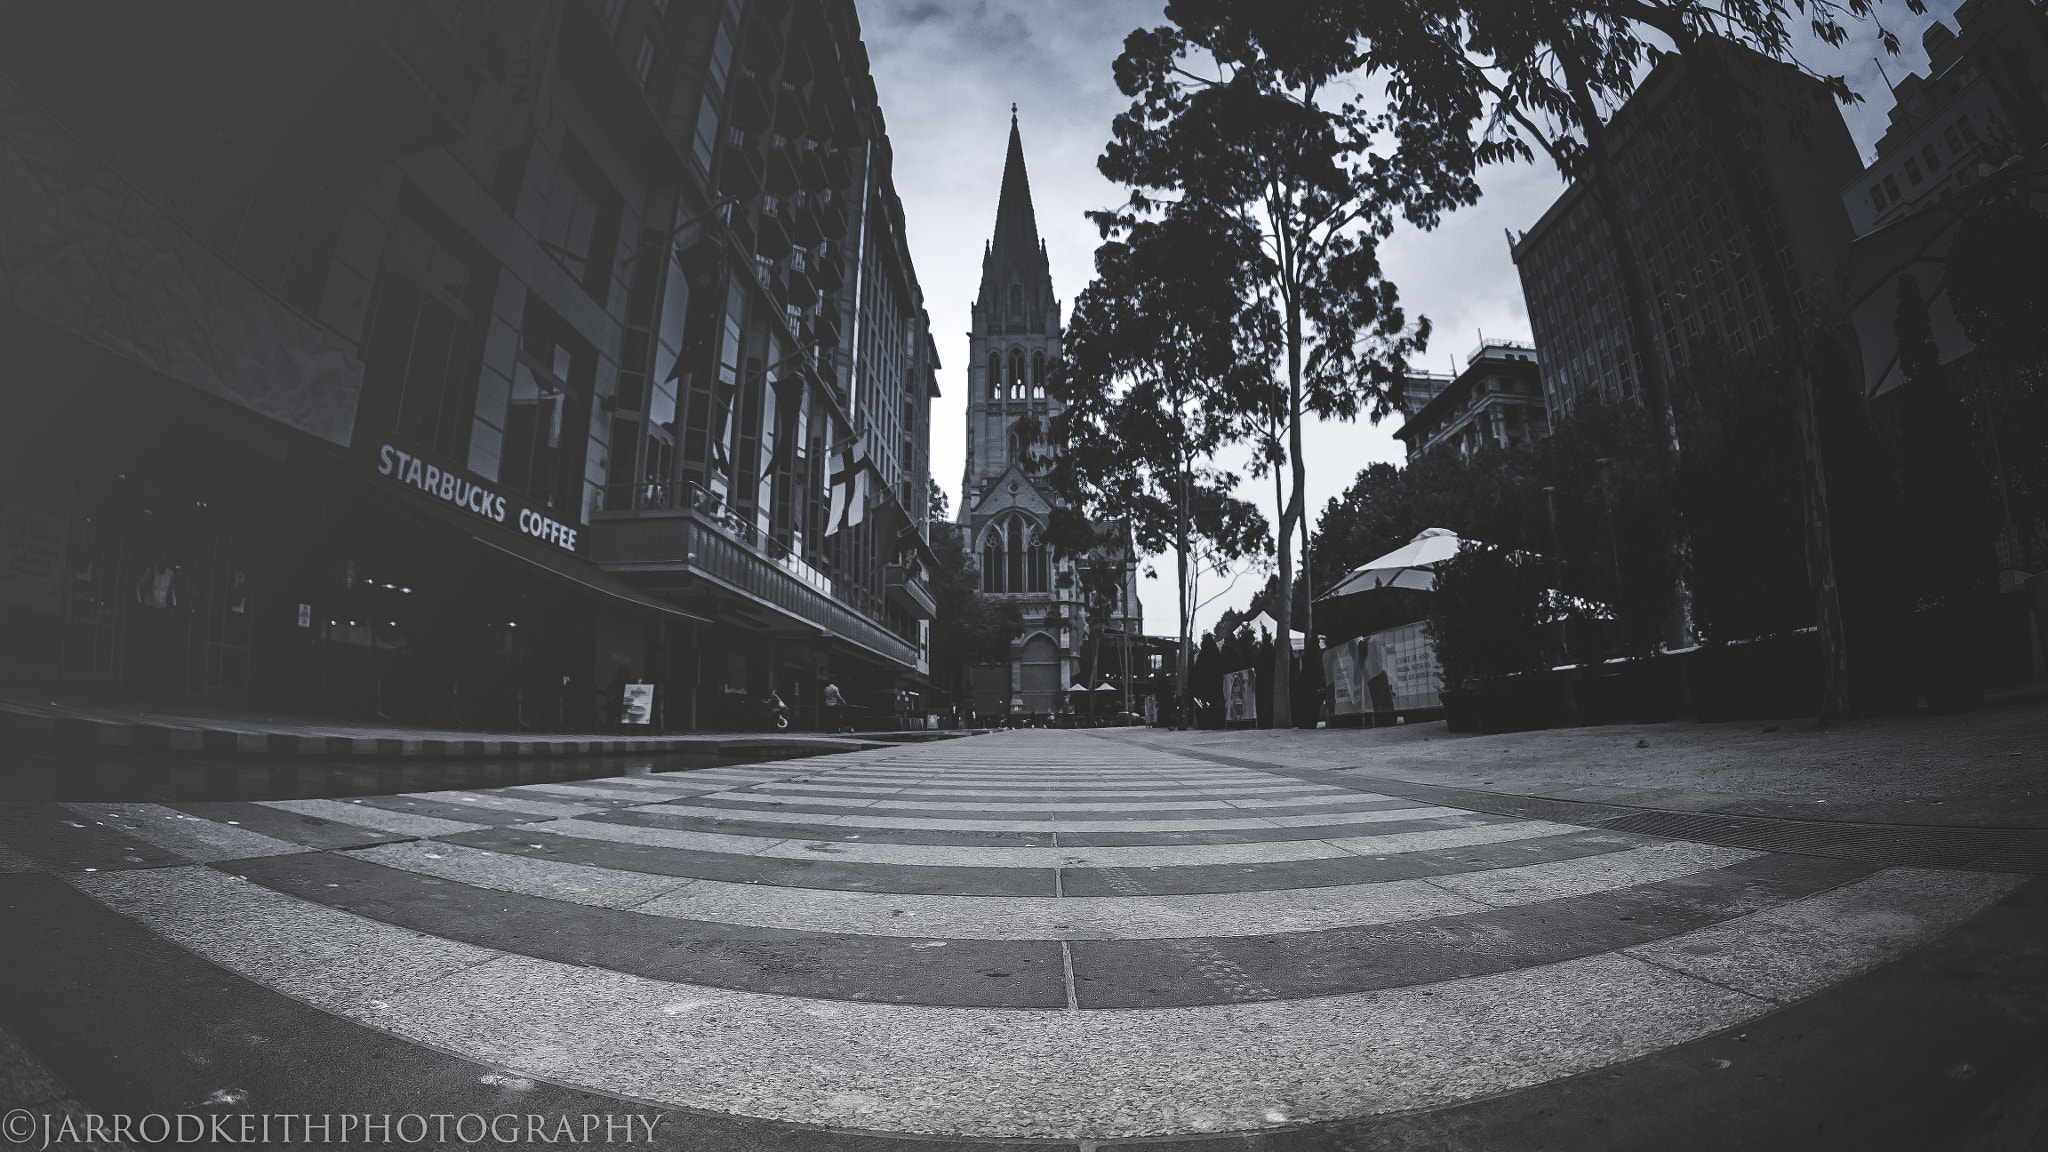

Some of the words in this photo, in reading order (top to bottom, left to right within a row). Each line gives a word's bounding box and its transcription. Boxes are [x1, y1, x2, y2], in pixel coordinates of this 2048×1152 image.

[510, 38, 532, 103] STIN
[378, 444, 507, 523] STARBUCKS
[519, 508, 578, 552] COFFEE
